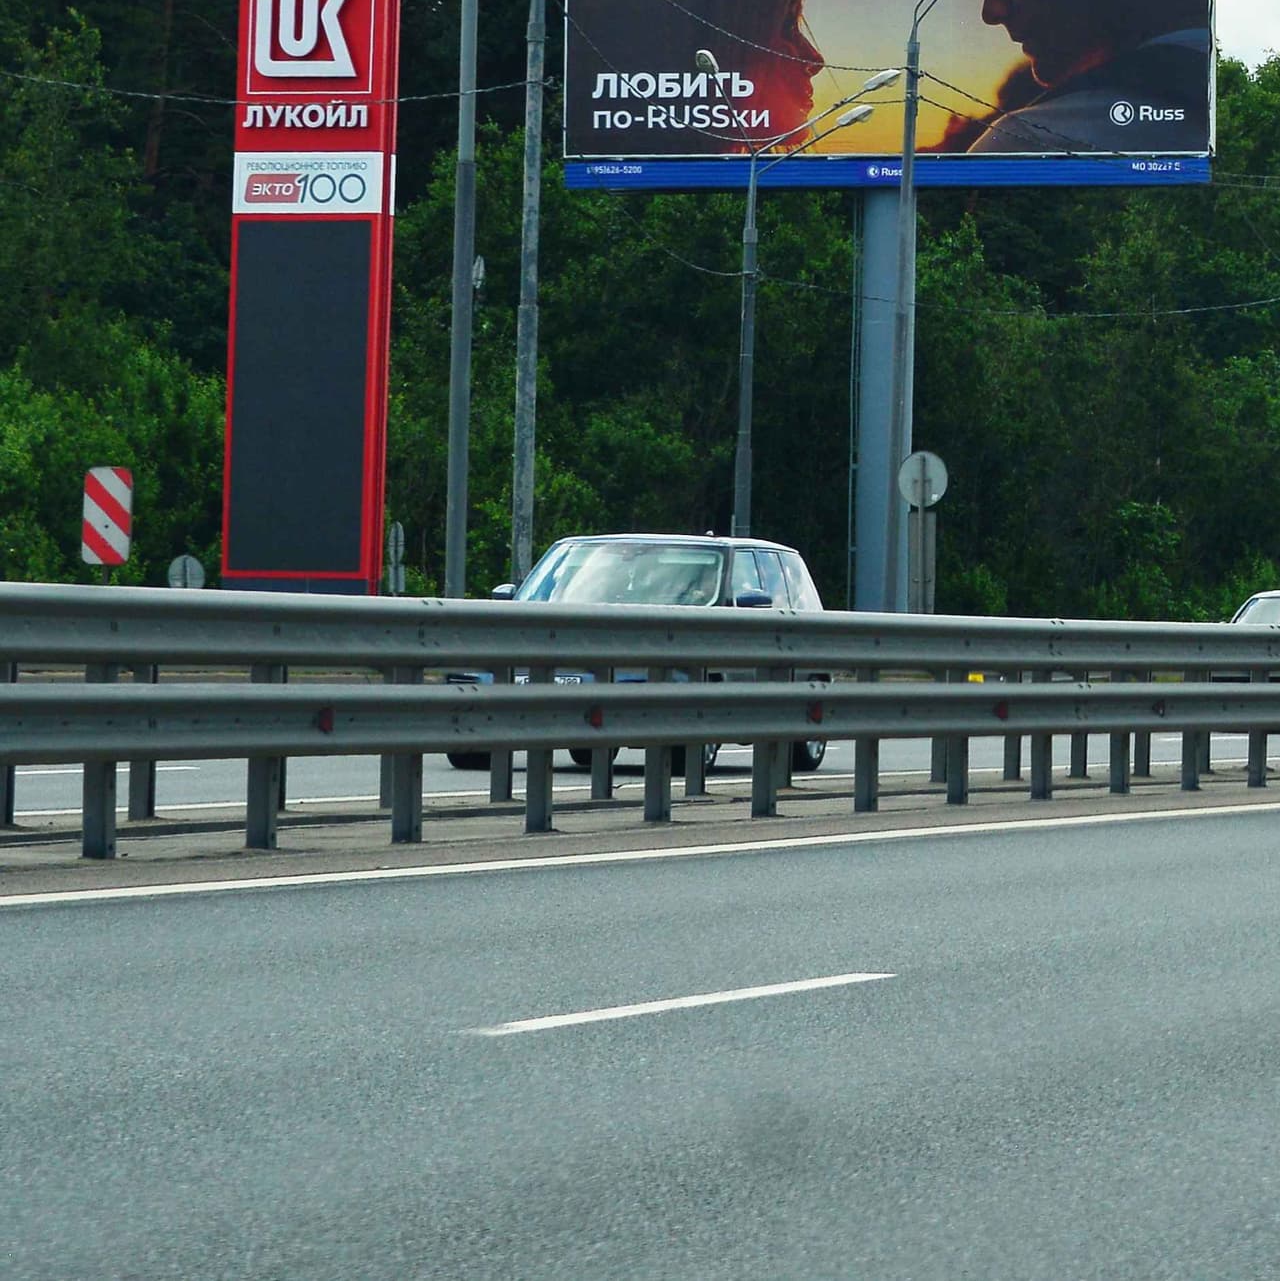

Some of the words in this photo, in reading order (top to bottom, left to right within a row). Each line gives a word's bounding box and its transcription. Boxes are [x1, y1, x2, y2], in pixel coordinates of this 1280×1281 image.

[592, 71, 755, 99] ЛЮБИТЬ
[242, 100, 369, 128] ЛУКОЙЛ
[1139, 105, 1185, 121] Russ
